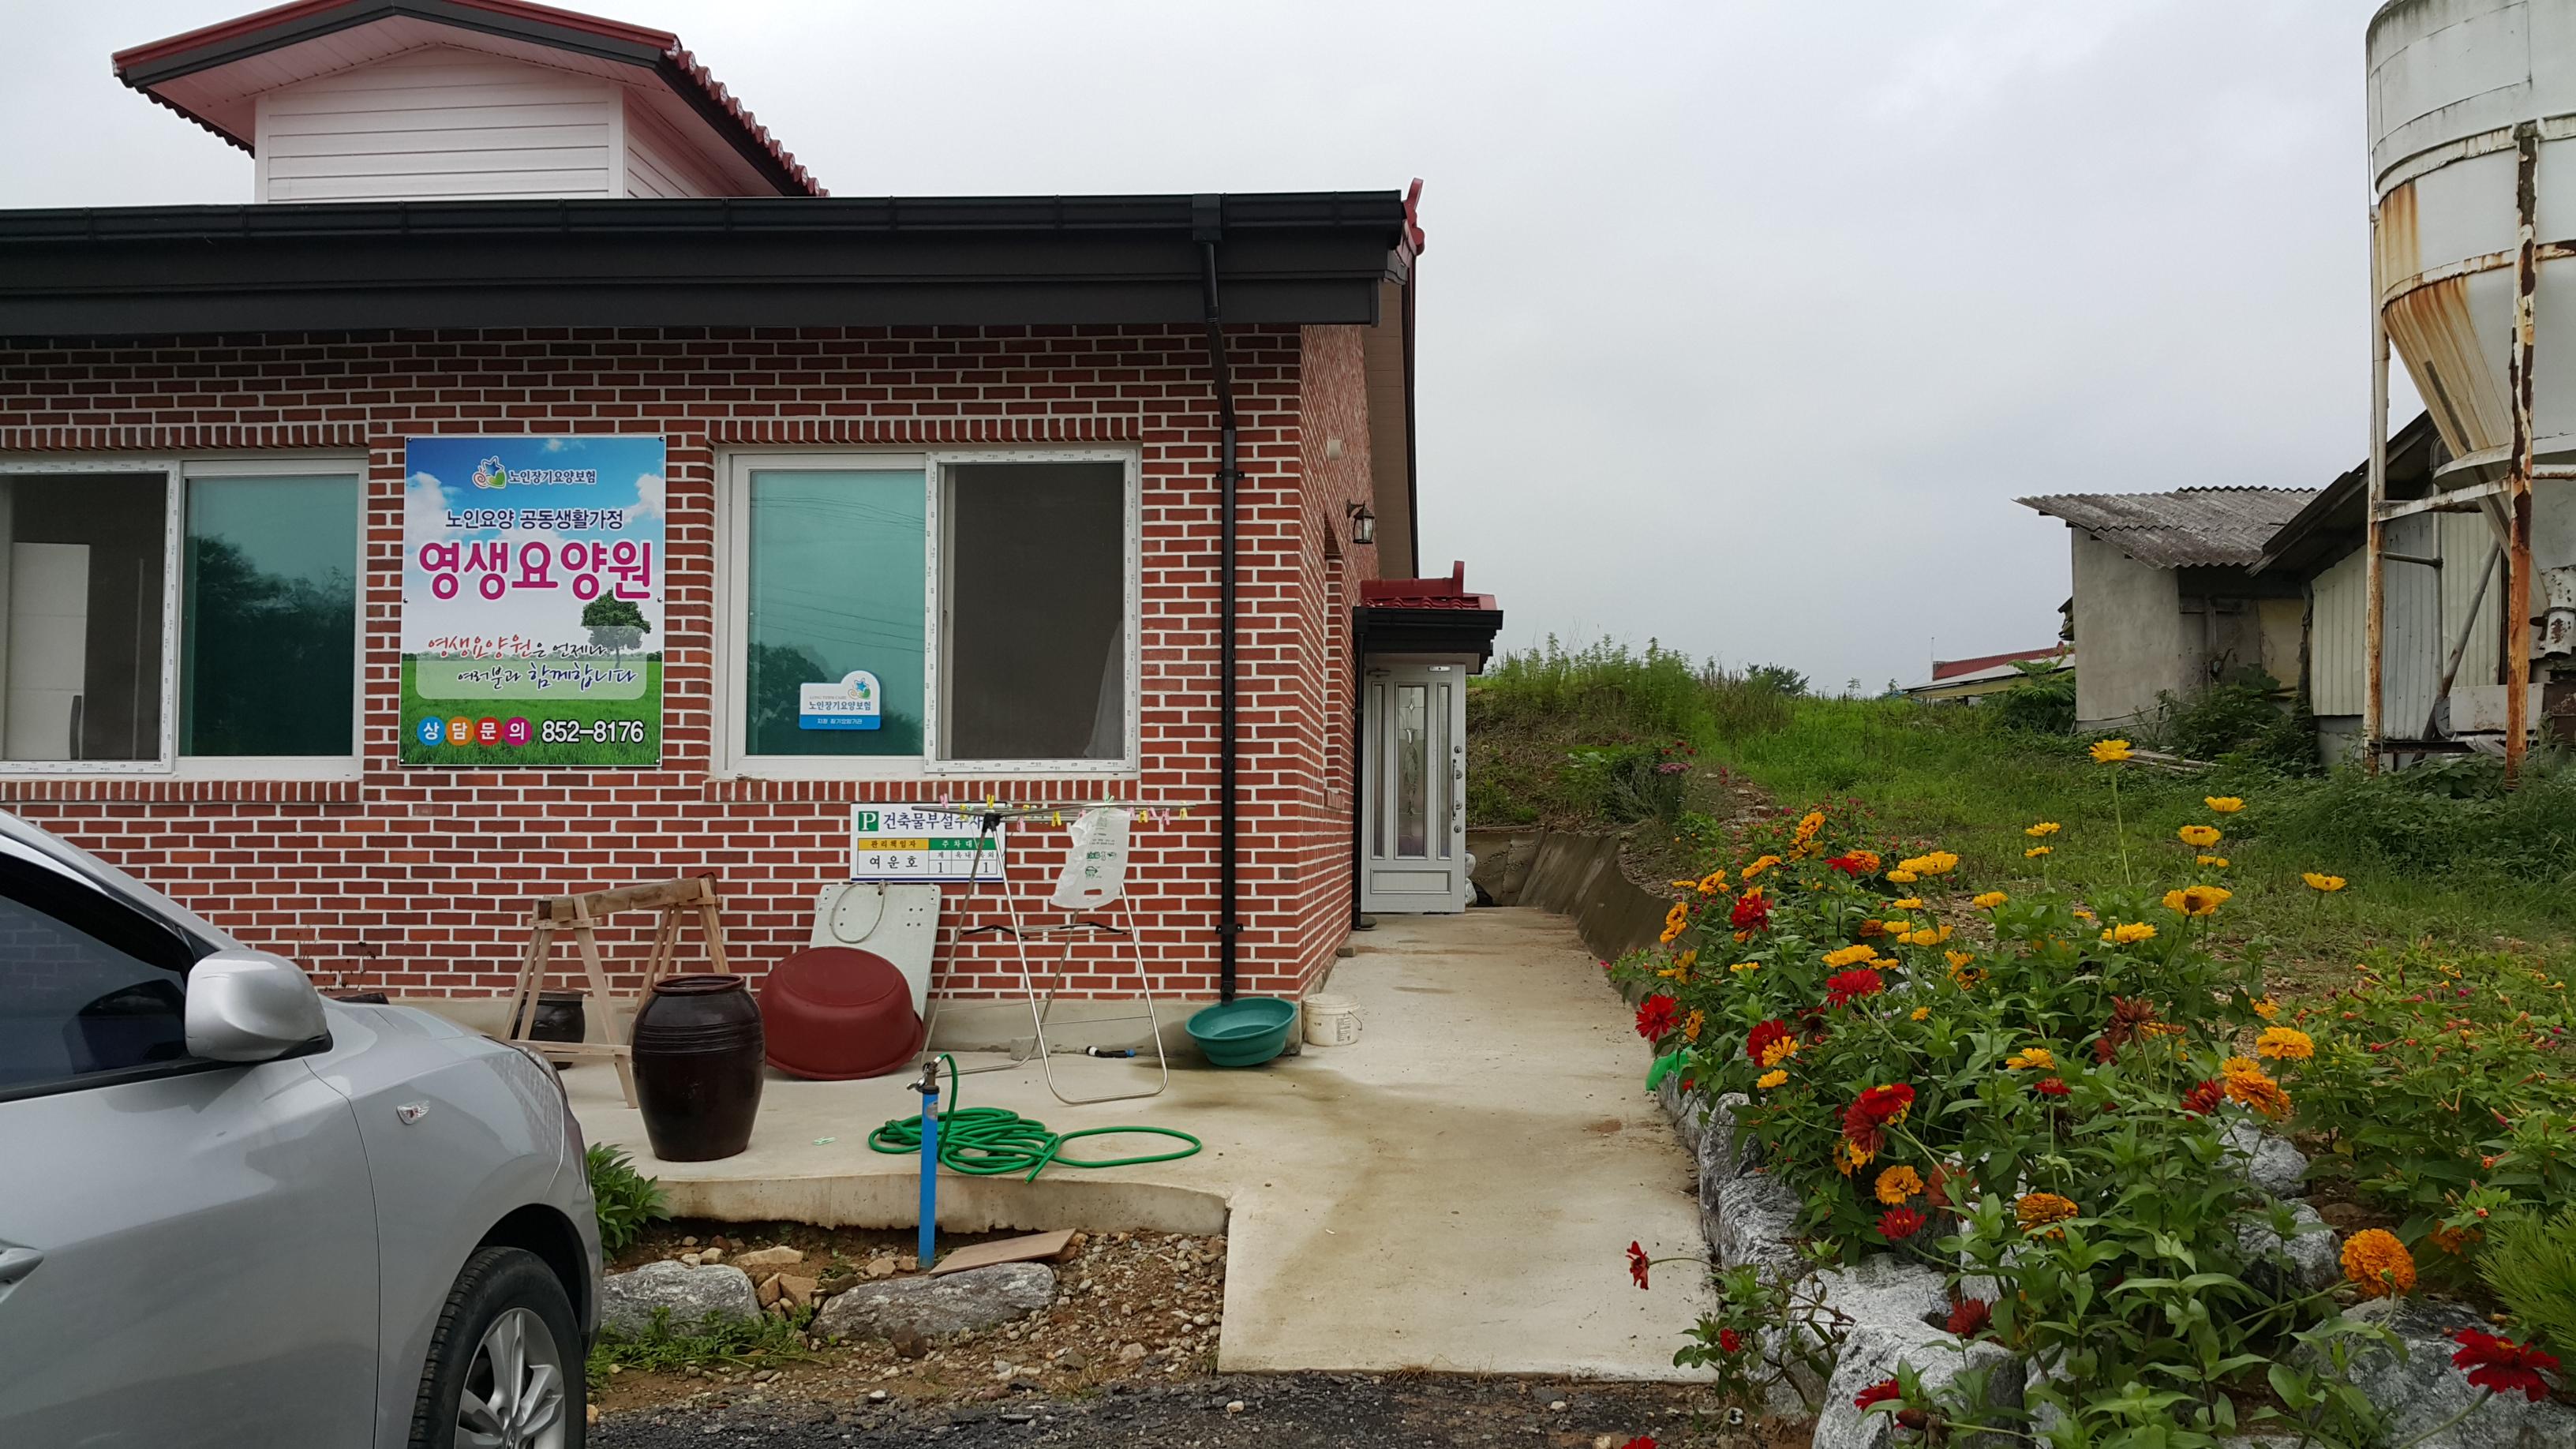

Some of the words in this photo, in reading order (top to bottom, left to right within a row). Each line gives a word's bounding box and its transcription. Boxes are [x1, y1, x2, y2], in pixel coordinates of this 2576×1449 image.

[509, 470, 596, 484] 노인장기요양보험
[445, 509, 515, 530] 노인요양
[519, 509, 623, 530] 공동생활가정
[419, 541, 651, 600] 영생요양원
[428, 635, 547, 659] 영생요양원은
[552, 642, 607, 657] 언제나
[457, 665, 522, 690] 여러분과
[528, 662, 638, 691] 함께합니다
[809, 701, 871, 711] 노인장기요양보험
[541, 720, 645, 743] 852-8176
[861, 812, 877, 830] P
[871, 840, 916, 848] 관리책임자
[870, 855, 919, 869] 여운호
[938, 862, 943, 873] 1
[983, 862, 989, 873] 1
